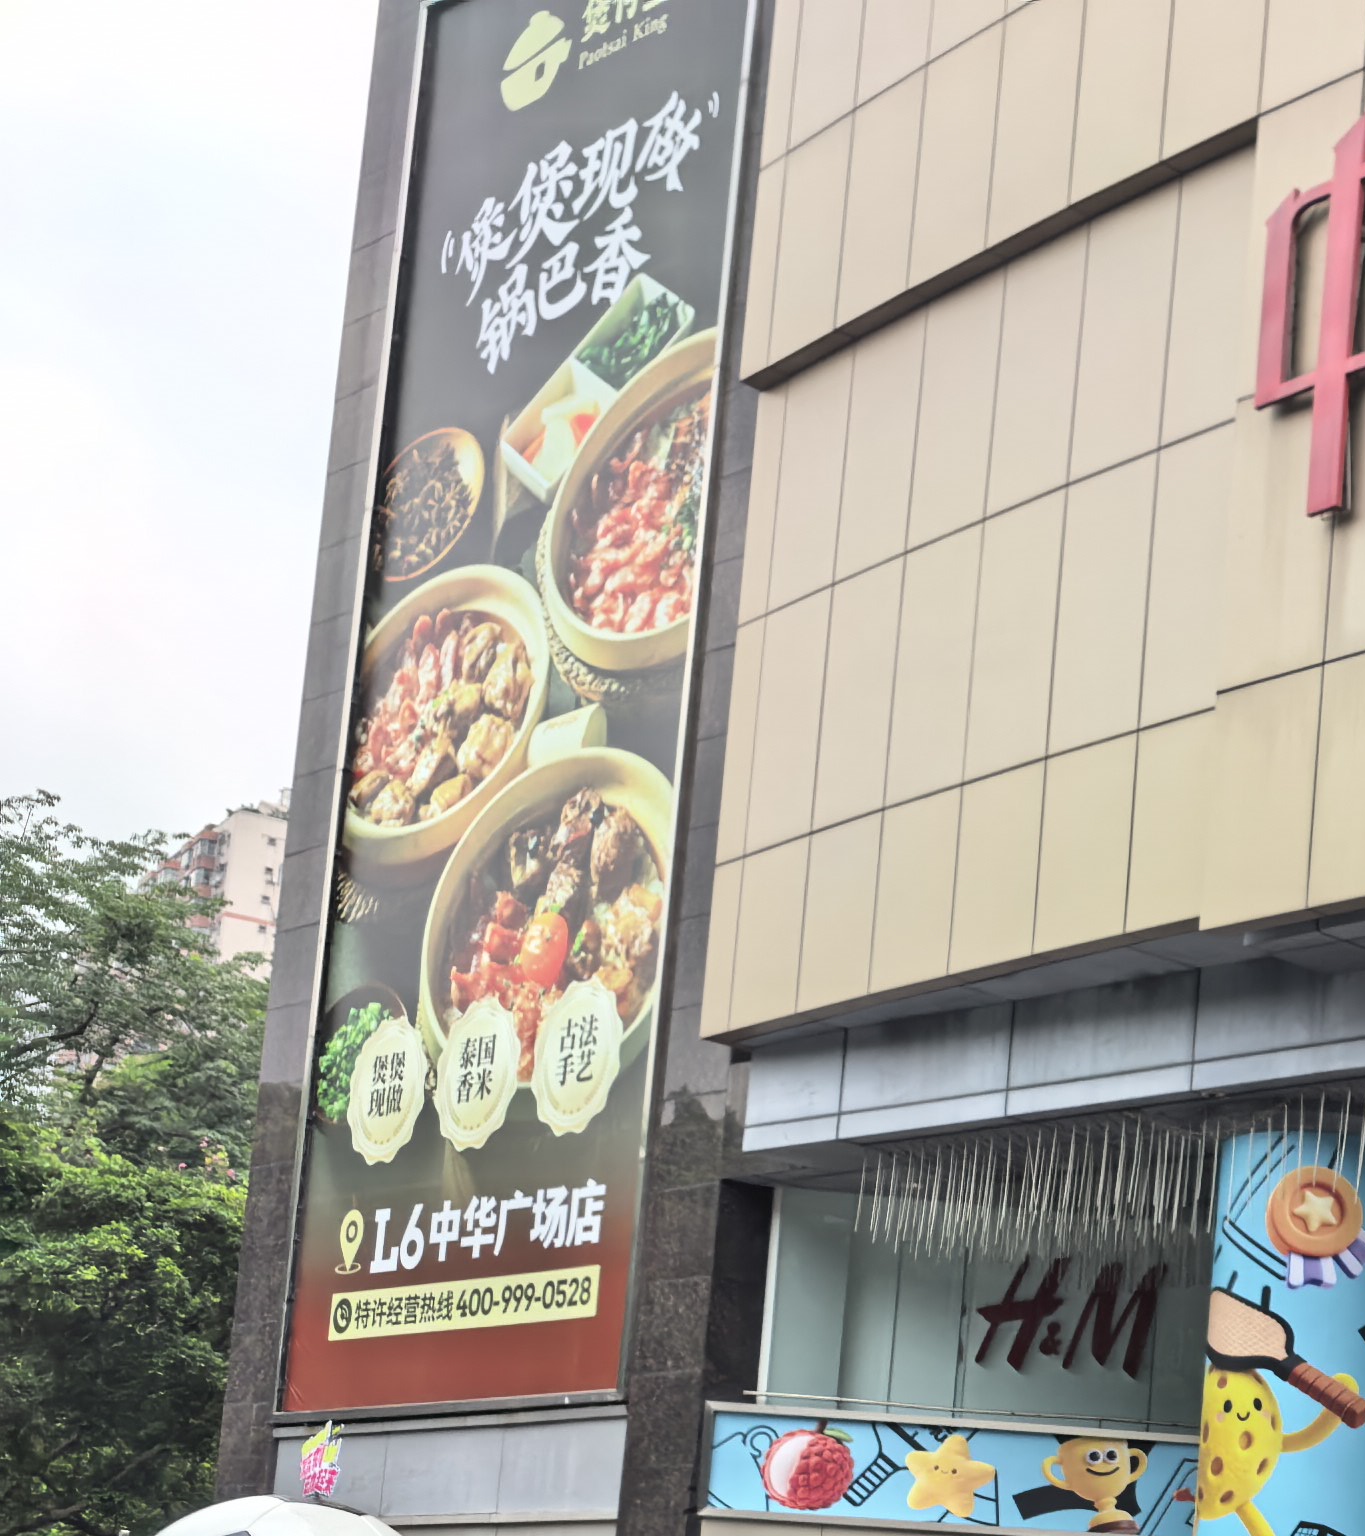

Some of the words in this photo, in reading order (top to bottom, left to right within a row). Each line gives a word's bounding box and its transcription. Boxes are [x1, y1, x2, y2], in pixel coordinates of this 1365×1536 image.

[632, 14, 669, 42] King
[476, 206, 651, 375] 锅巴香
[460, 1034, 497, 1069] 泰国
[559, 1014, 599, 1053] 古法
[372, 1051, 406, 1086] 煲煲
[456, 1067, 493, 1104] 香米
[555, 1052, 594, 1087] 手艺
[367, 1084, 404, 1119] 现做
[369, 1178, 607, 1274] L6中华广场店
[975, 1252, 1169, 1381] H&M
